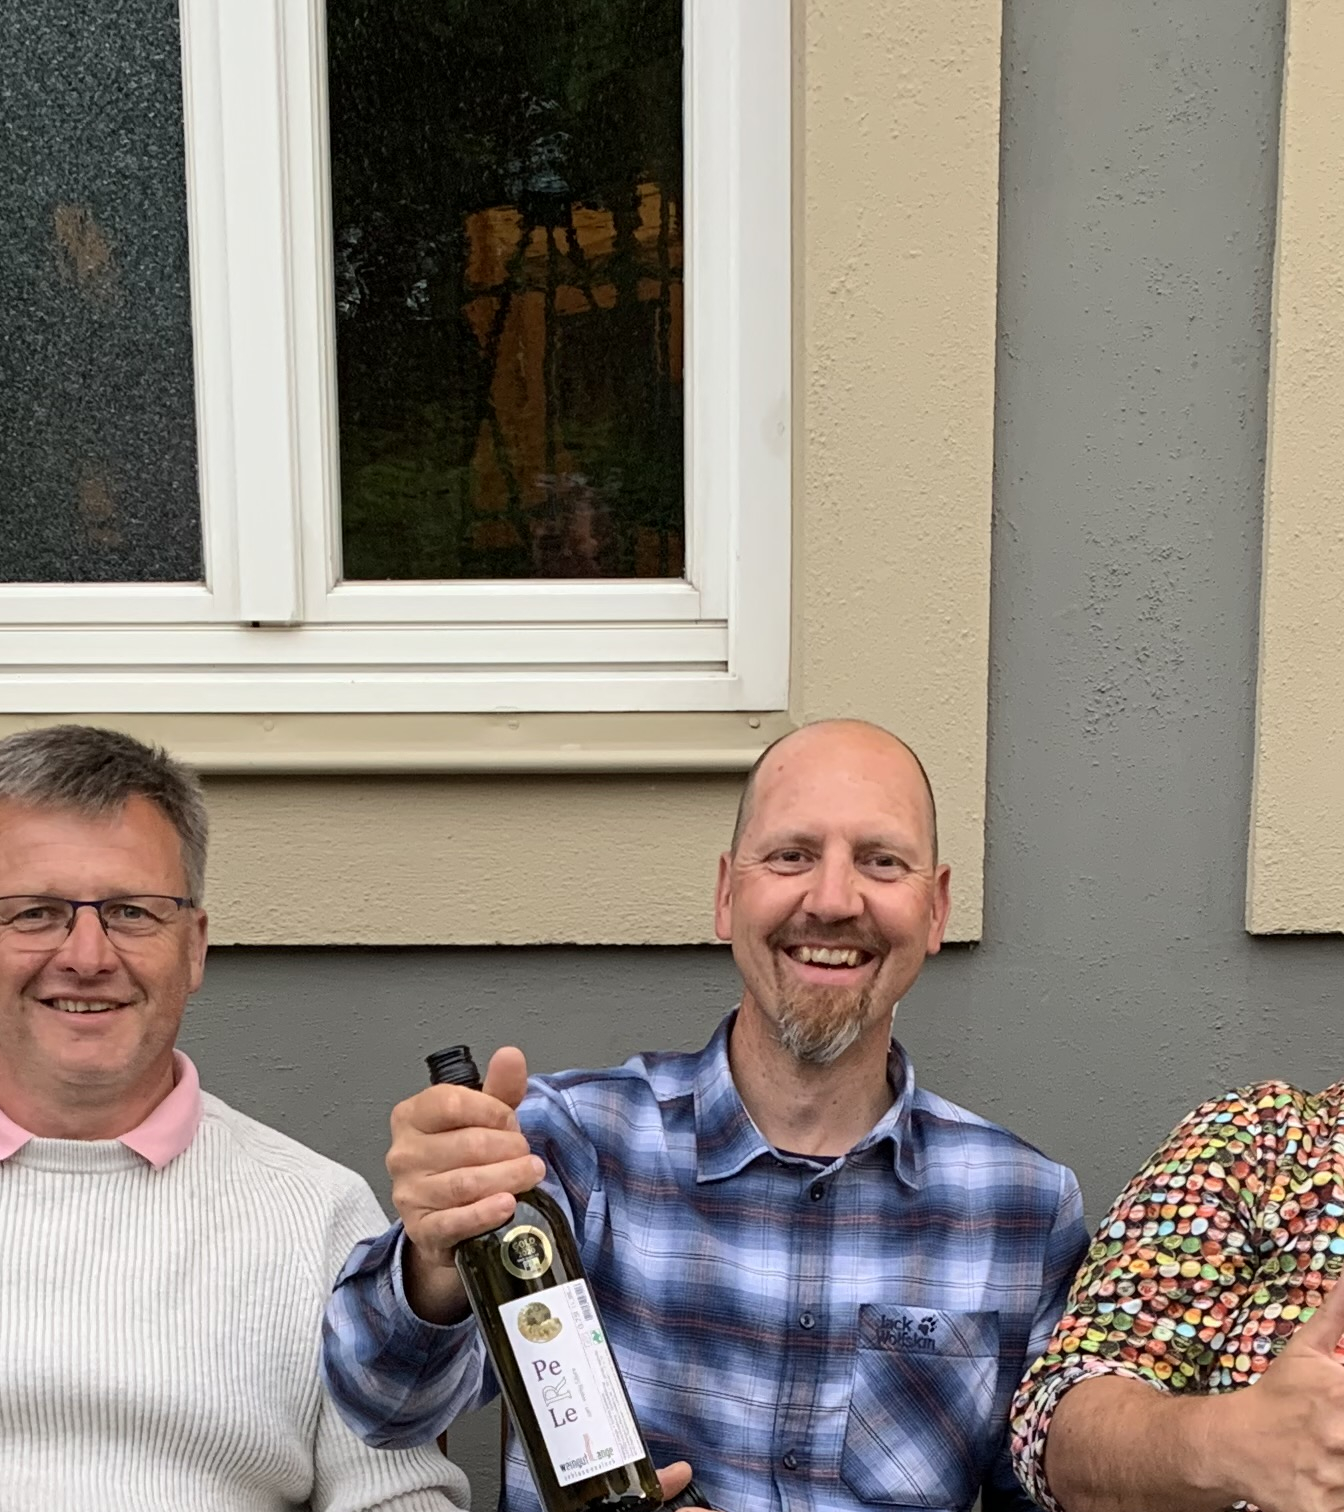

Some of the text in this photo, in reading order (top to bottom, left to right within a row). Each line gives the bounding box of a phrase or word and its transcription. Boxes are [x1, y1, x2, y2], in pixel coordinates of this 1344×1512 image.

[511, 1236, 537, 1250] GOLD
[880, 1314, 913, 1331] Jack
[875, 1328, 936, 1351] Wolfskin
[532, 1359, 562, 1382] Pe
[542, 1376, 573, 1407] R
[548, 1407, 579, 1428] Le
